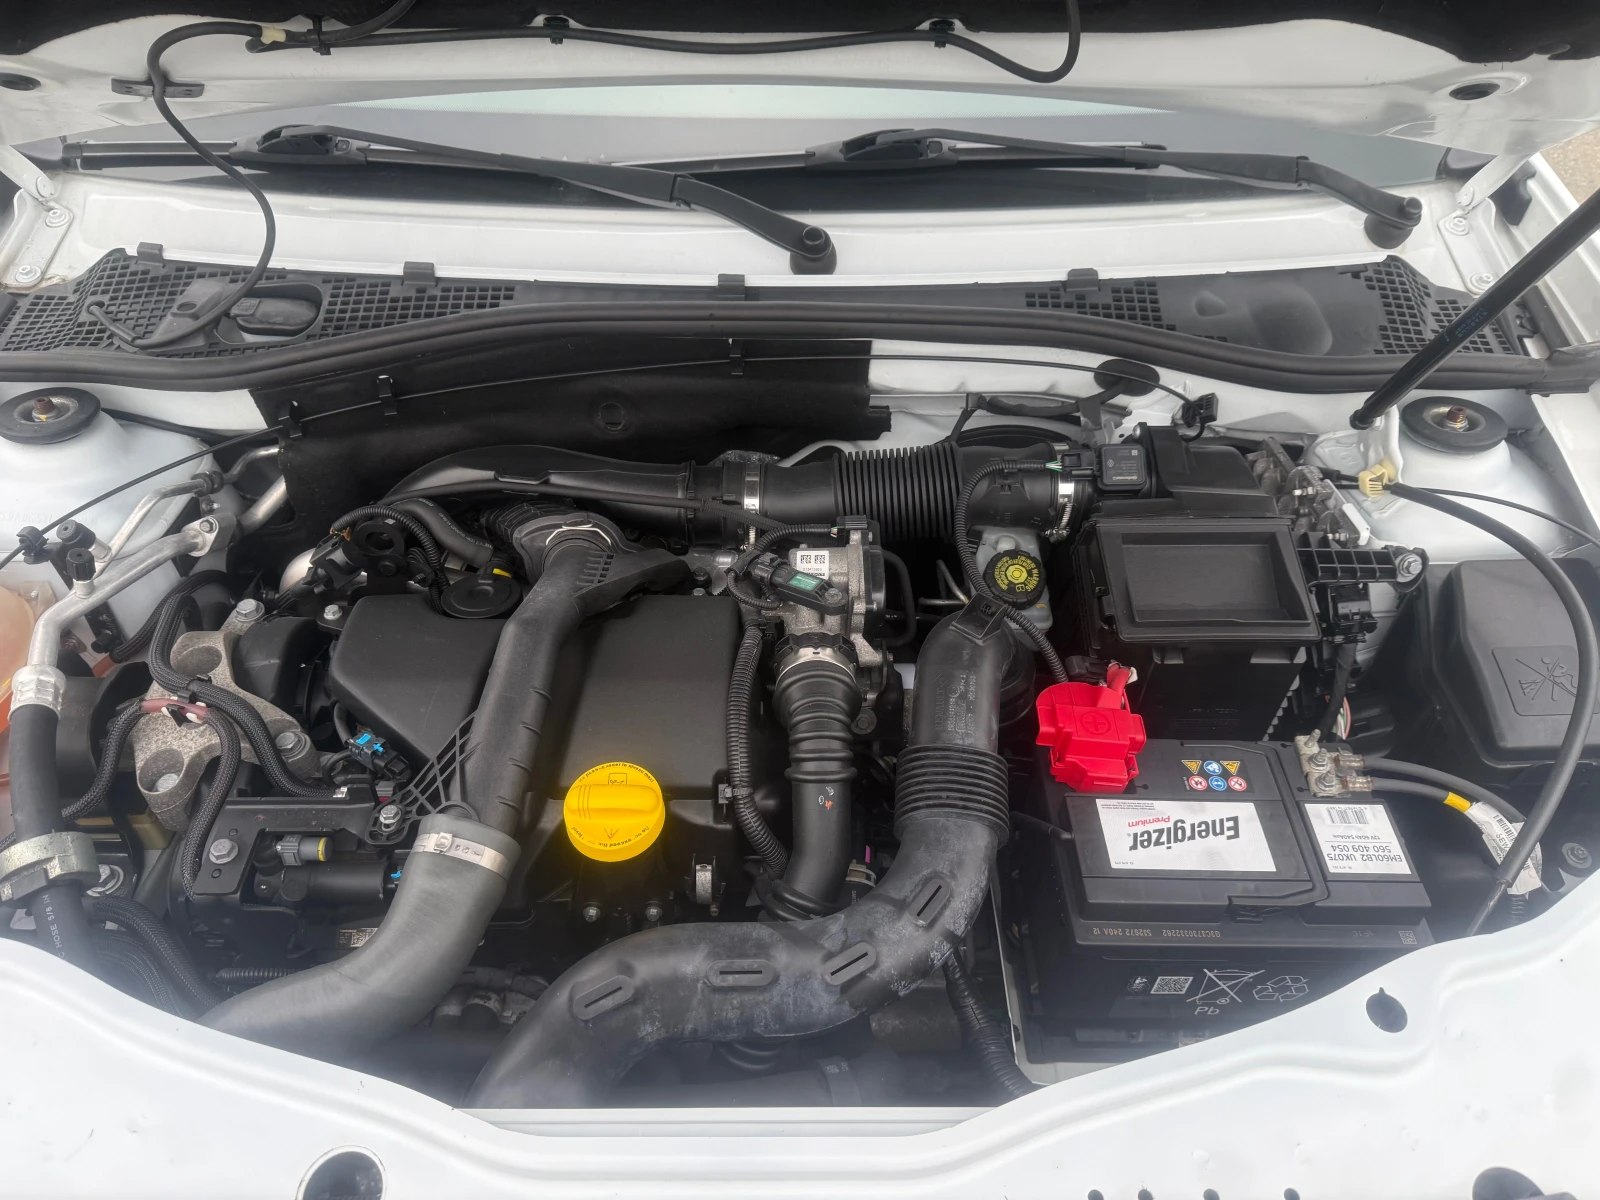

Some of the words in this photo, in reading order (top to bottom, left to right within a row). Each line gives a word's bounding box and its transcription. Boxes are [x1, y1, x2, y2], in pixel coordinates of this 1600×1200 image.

[1128, 815, 1171, 828] Premium
[1129, 815, 1240, 851] Energizer
[609, 838, 632, 848] exceed
[1331, 844, 1350, 852] 054
[1352, 844, 1370, 853] 409
[1372, 845, 1392, 853] 560
[1326, 853, 1357, 861] UK075
[1361, 853, 1403, 862] EM60LB2
[50, 923, 63, 948] HOSE
[1194, 1006, 1220, 1016] Pb
